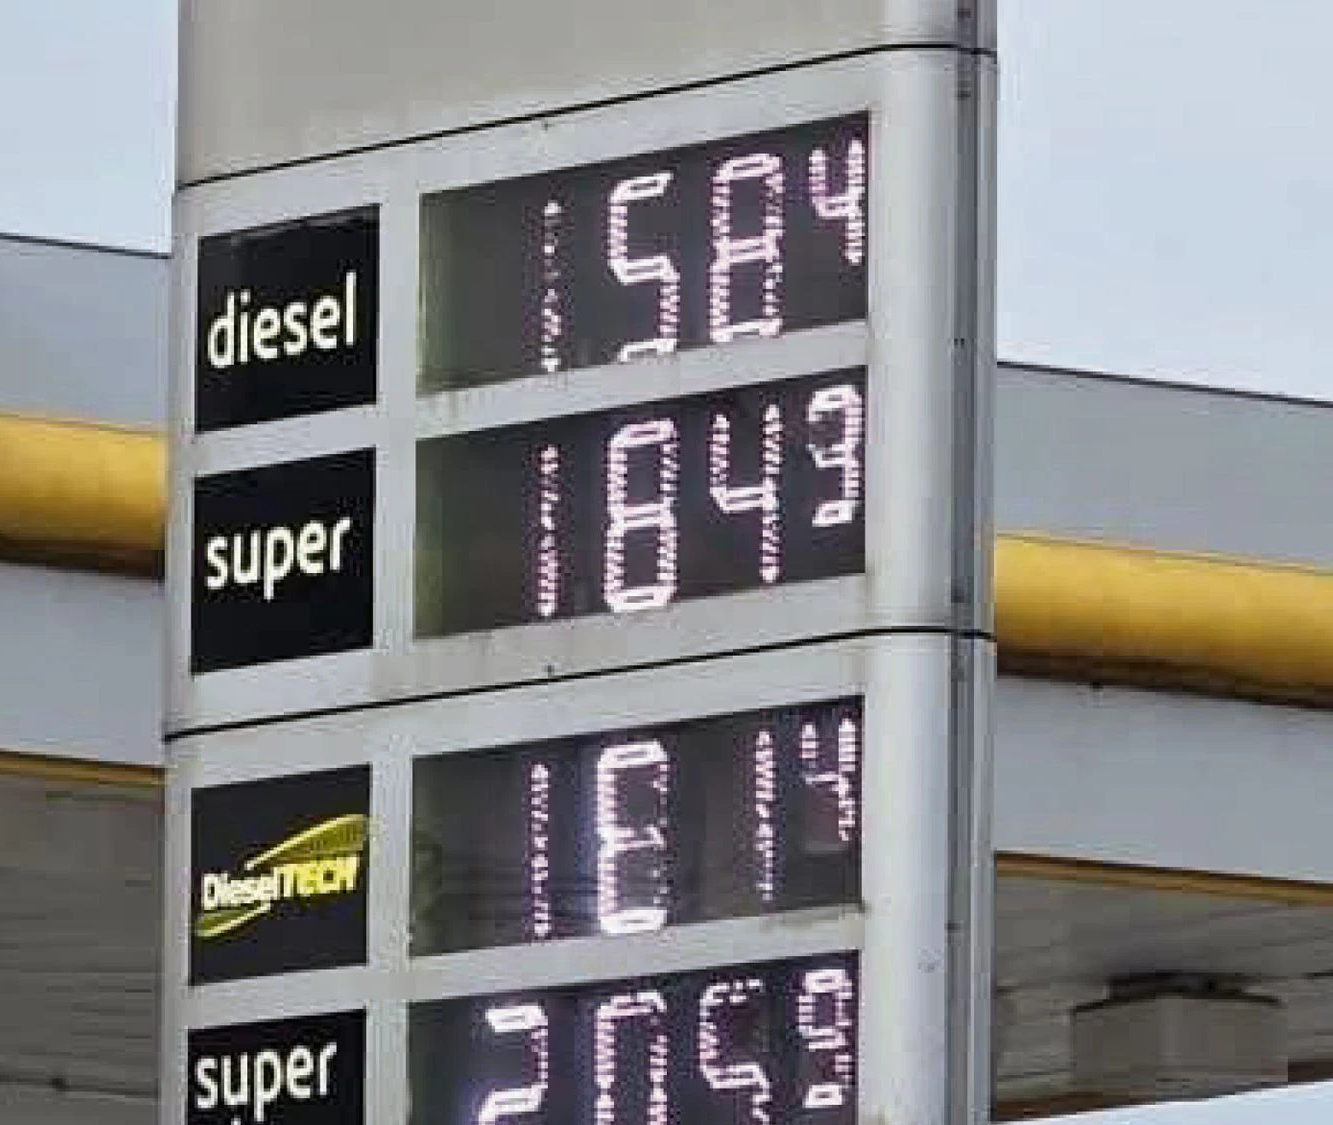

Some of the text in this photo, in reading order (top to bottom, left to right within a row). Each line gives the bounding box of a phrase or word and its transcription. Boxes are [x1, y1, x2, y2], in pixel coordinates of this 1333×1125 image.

[208, 272, 356, 368] diesel
[205, 512, 351, 602] super
[195, 1041, 336, 1121] super
